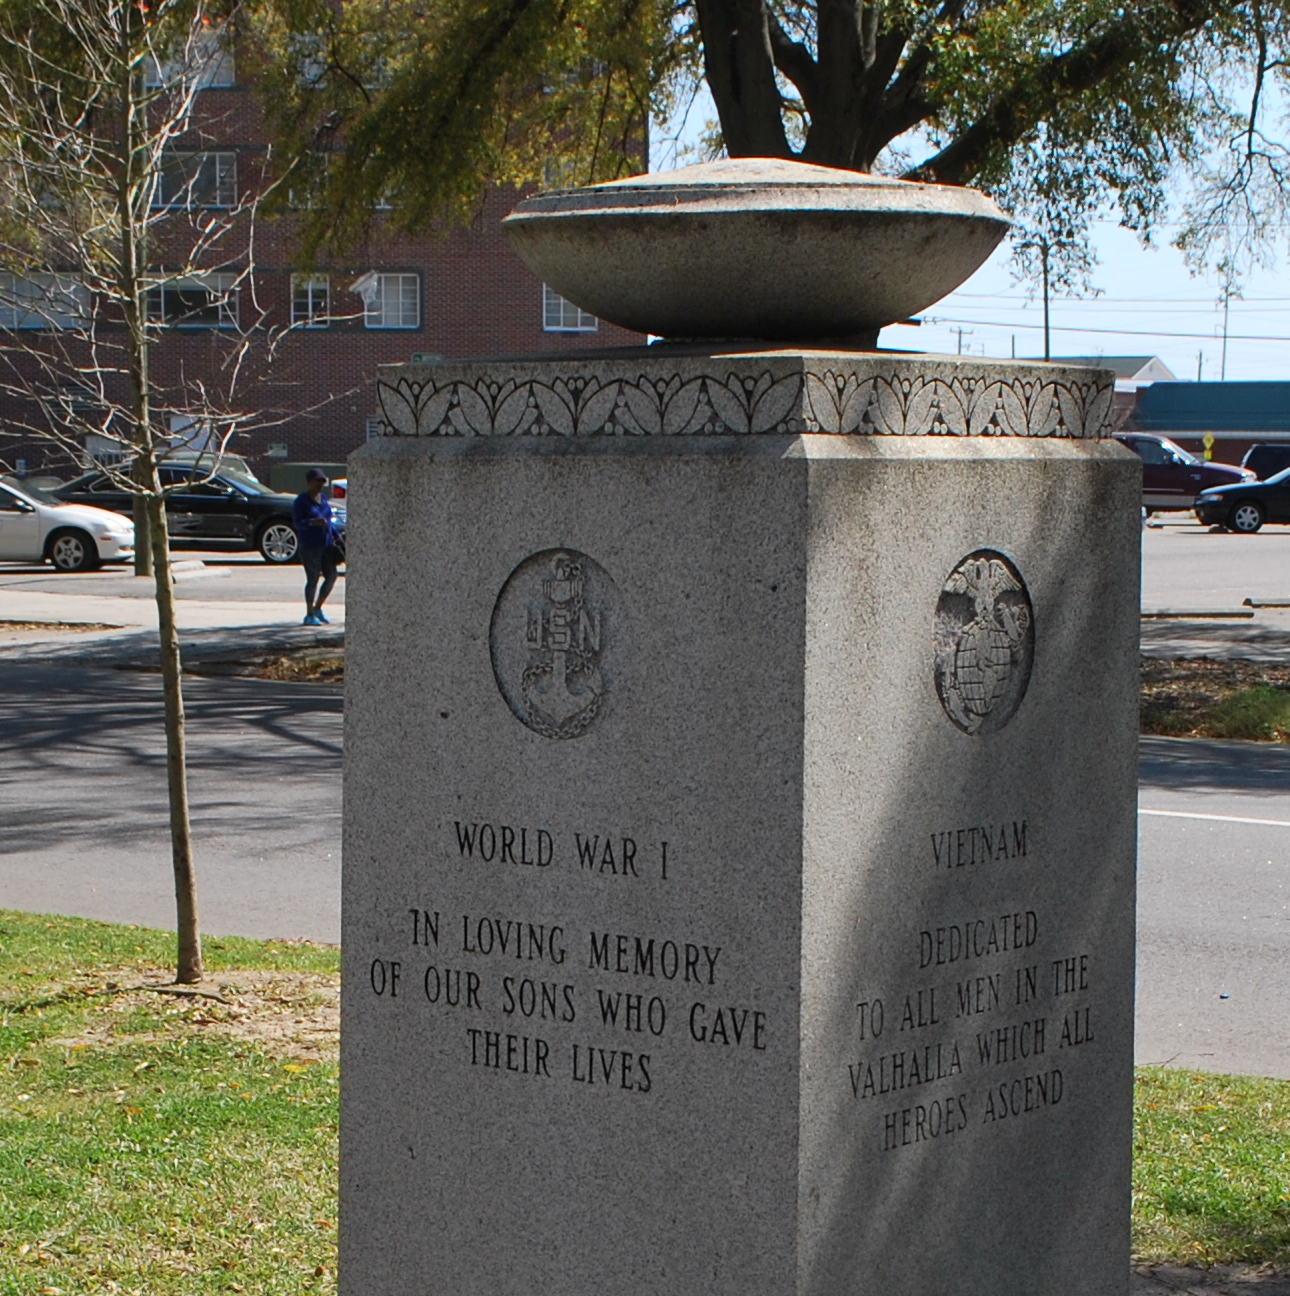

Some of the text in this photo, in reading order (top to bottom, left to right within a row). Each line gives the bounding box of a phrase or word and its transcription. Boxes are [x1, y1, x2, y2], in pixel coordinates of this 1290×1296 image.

[453, 821, 670, 881] WORLD WAR I
[930, 820, 1028, 870] VIETNAM
[409, 908, 722, 986] IN LOVING MEMORY
[919, 910, 1038, 970] DEDICATED
[370, 958, 767, 1050] OF OUR SONS WHO GAVE
[857, 954, 1089, 1040] TO ALL MEN IN THE
[466, 1028, 652, 1094] THEIR LIVES
[847, 1007, 1095, 1100] VALHALLA WHICH ALL
[883, 1069, 1064, 1151] HEROES ASCEND
